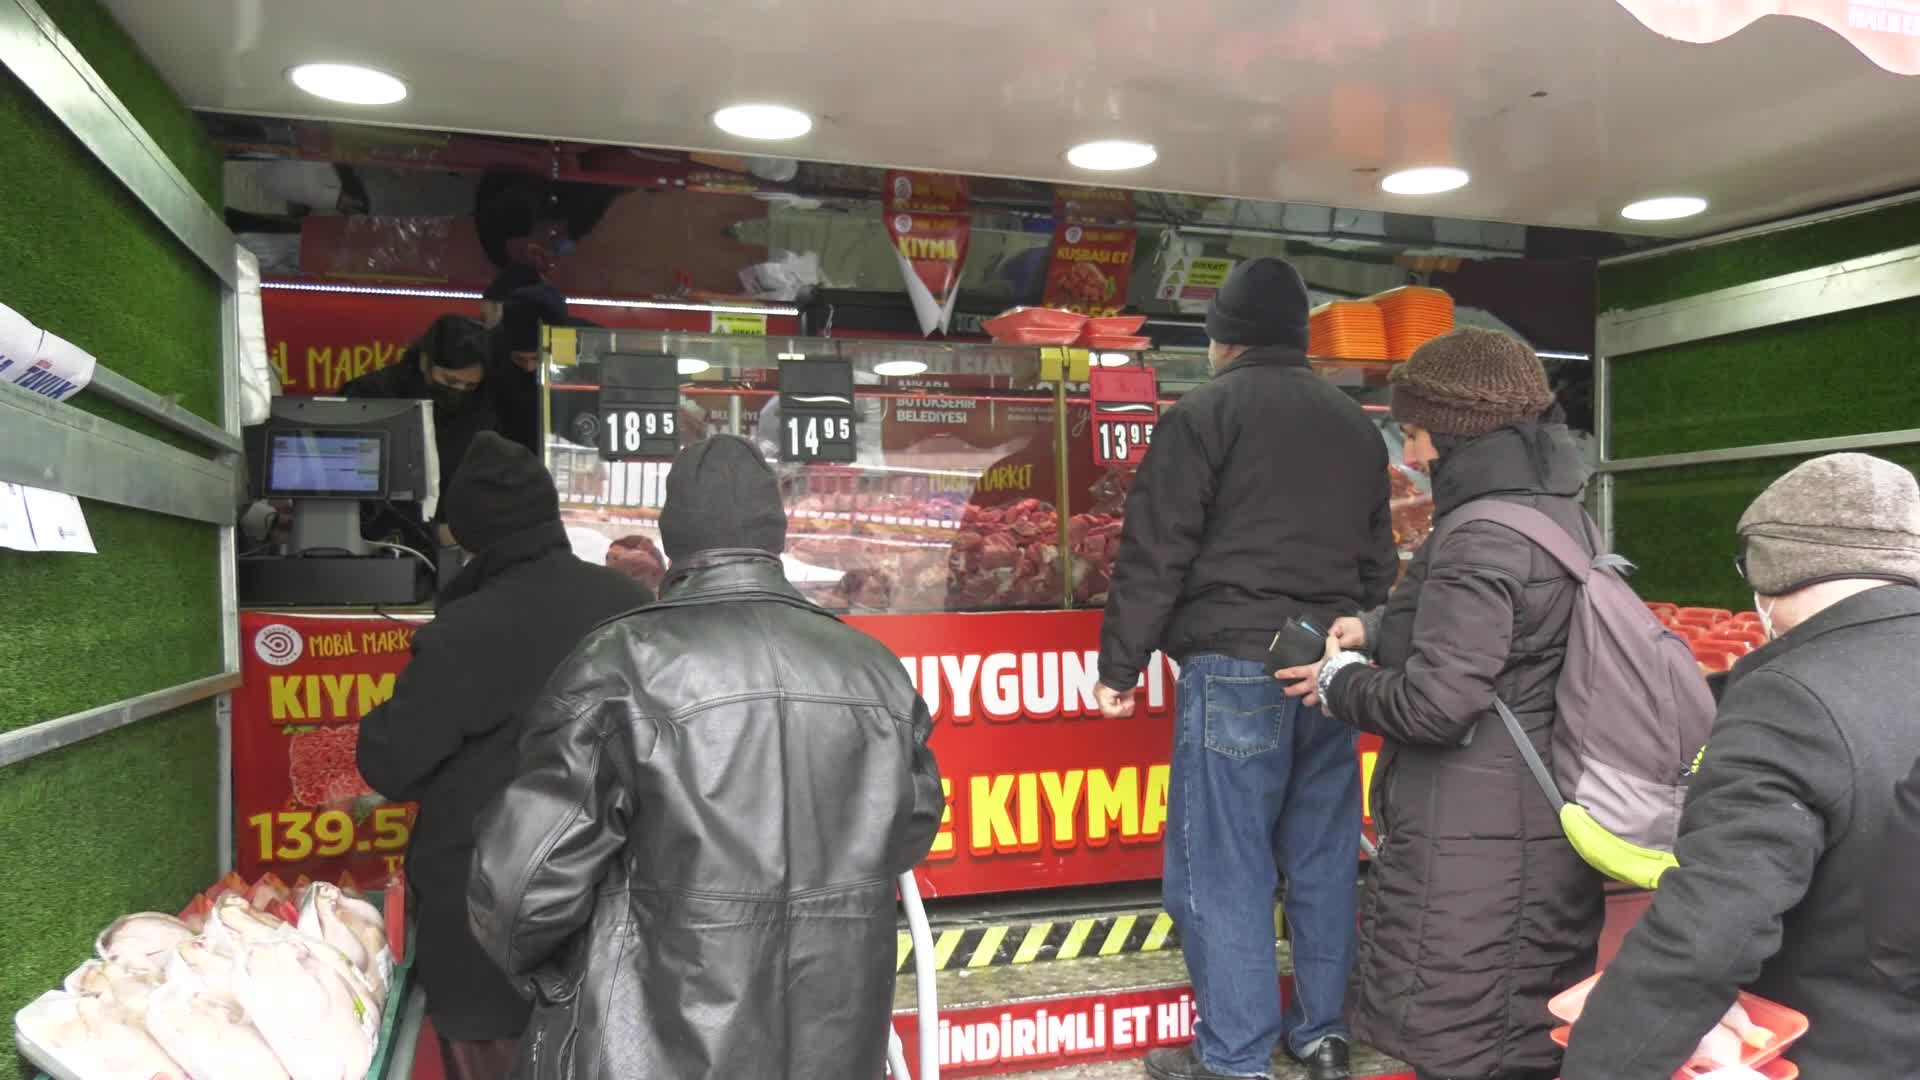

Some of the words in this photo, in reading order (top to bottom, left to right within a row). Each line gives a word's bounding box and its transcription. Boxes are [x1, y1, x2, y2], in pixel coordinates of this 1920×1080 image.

[13, 365, 78, 400] TAVUK
[307, 341, 406, 389] MARK
[606, 411, 640, 451] 18
[787, 417, 819, 455] 14
[1099, 423, 1128, 460] 13
[269, 672, 397, 719] KIYM
[970, 764, 1171, 849] KIYMA
[249, 809, 416, 860] 139.5
[1112, 1005, 1150, 1046] ET
[1157, 994, 1197, 1040] Hİ
